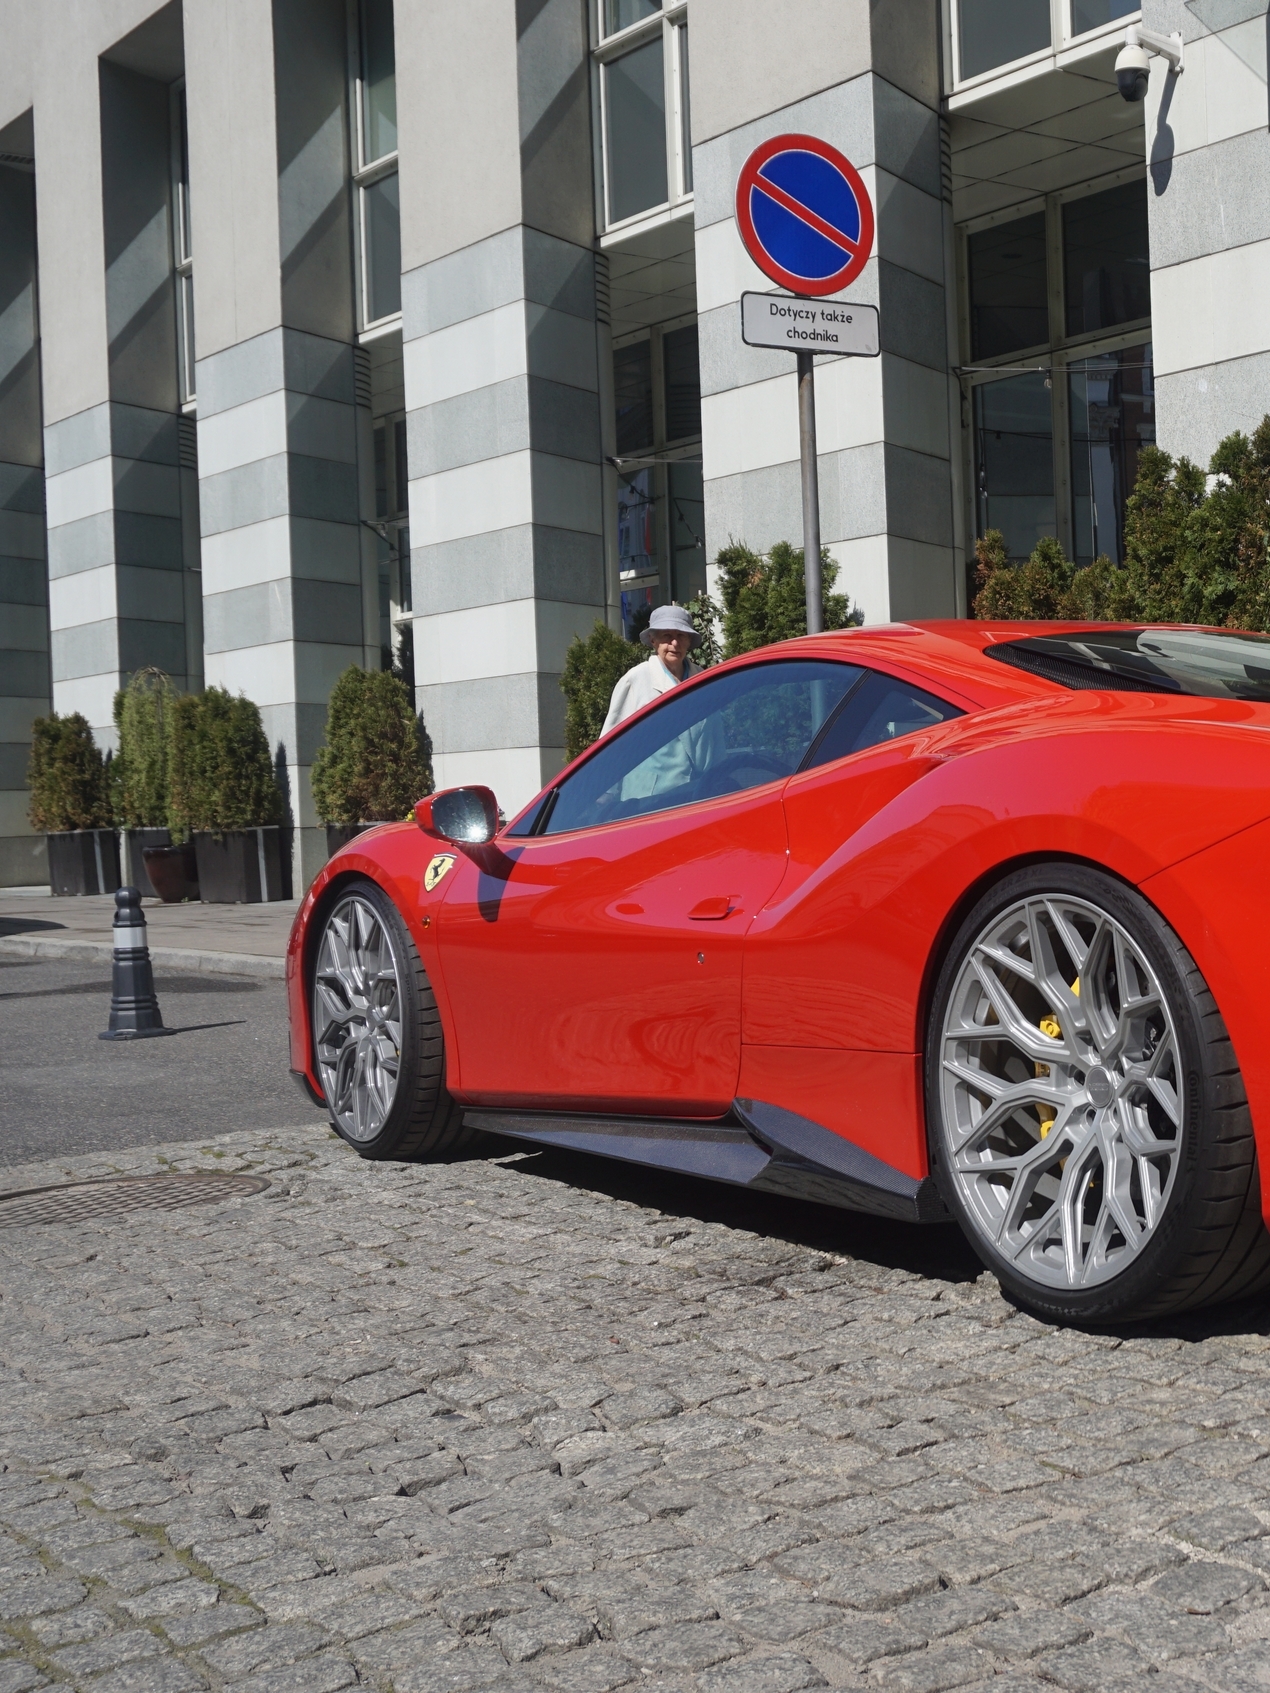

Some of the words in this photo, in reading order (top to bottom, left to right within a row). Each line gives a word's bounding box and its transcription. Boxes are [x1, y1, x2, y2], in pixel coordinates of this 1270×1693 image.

[769, 303, 817, 323] Dotyczy
[820, 309, 853, 324] także
[786, 326, 839, 343] chodnika
[1187, 1070, 1201, 1161] Continental
